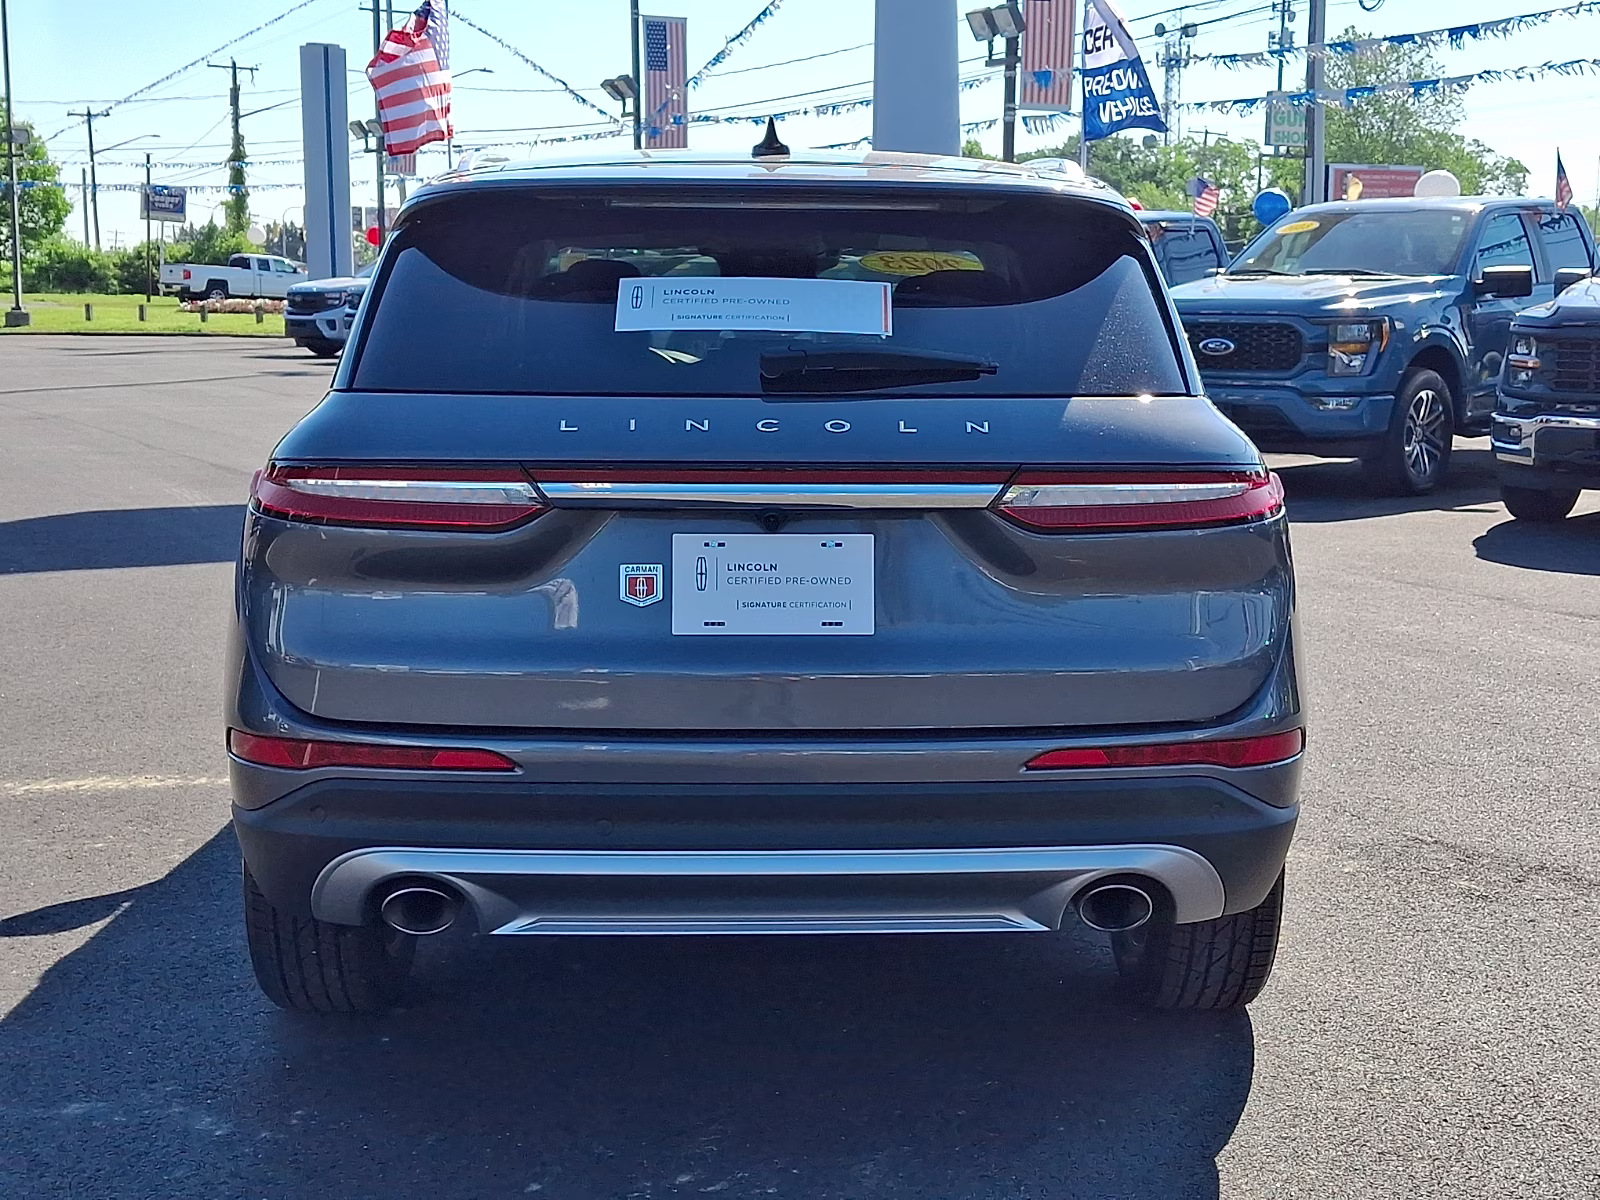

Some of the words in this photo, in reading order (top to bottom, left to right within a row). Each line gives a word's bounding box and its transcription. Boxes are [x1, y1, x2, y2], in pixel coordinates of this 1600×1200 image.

[1084, 67, 1143, 98] PRE-OW
[663, 288, 716, 296] LINCOLN
[662, 297, 719, 305] CERTIFIED
[722, 298, 791, 306] PRE-OWNED
[559, 418, 990, 434] LINCOLN
[624, 565, 659, 573] CARMAN
[726, 562, 779, 572] LINCOLN
[726, 576, 782, 586] CERTIFIED
[785, 576, 853, 586] PRE-OWNED
[741, 601, 787, 609] SIGNATURE
[789, 601, 847, 609] CERTIFICATION
